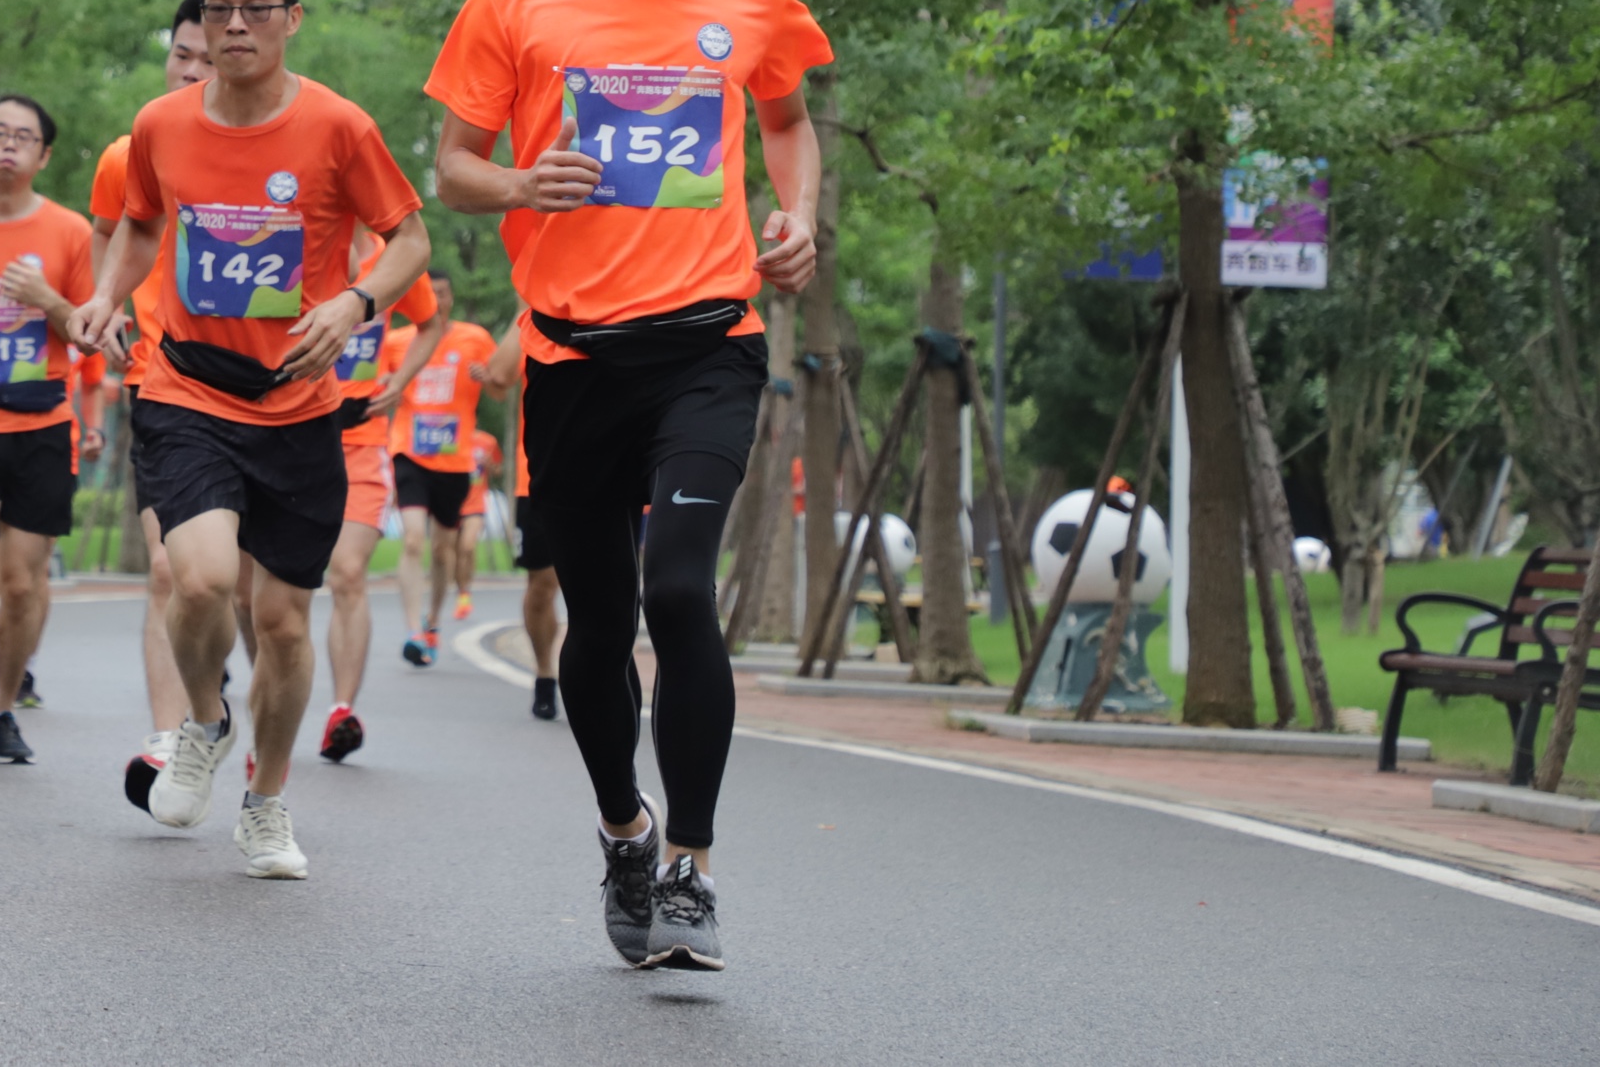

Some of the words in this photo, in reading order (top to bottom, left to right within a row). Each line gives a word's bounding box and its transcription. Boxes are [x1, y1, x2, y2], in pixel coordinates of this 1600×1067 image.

[589, 74, 629, 95] 2020
[594, 123, 700, 166] 152
[195, 212, 226, 230] 2020
[198, 250, 284, 285] 142
[342, 336, 377, 360] 45
